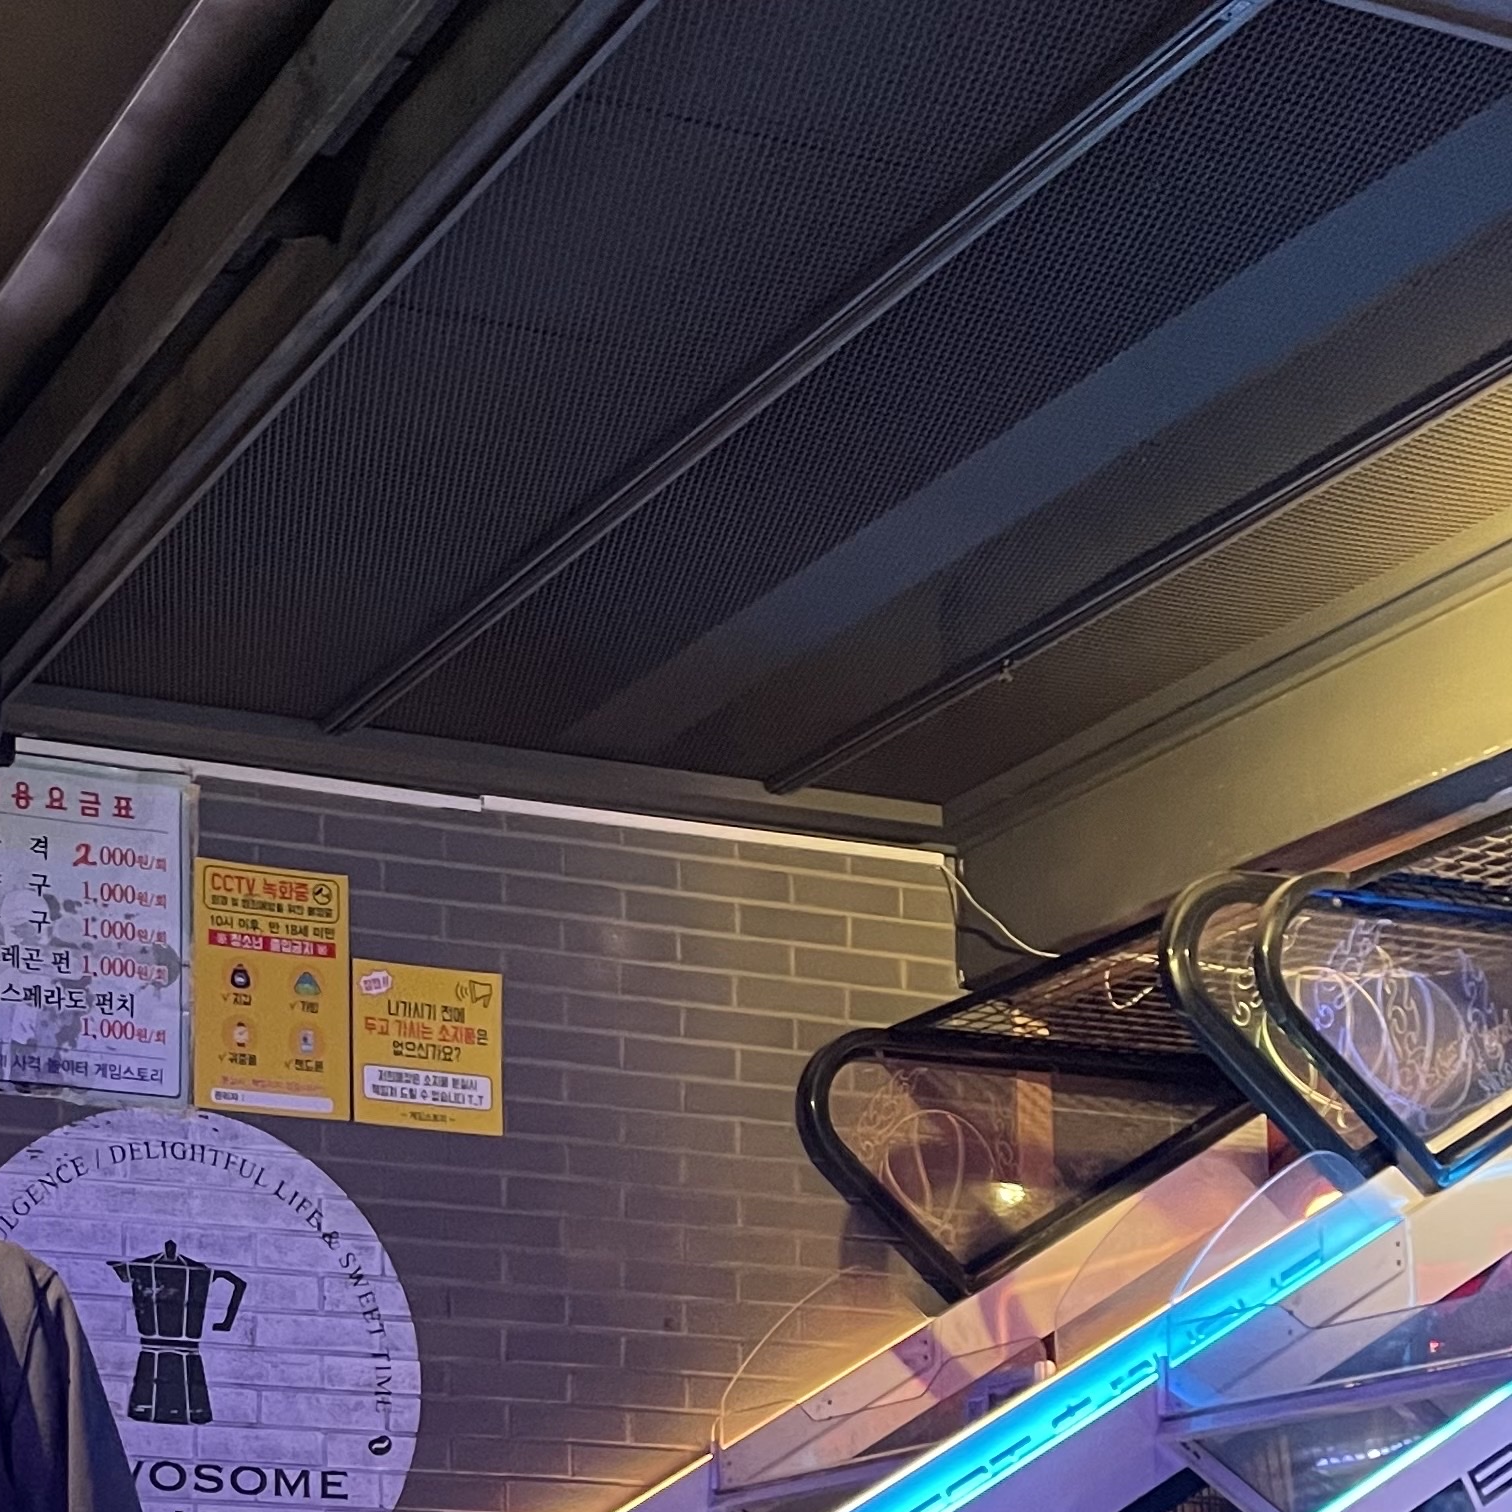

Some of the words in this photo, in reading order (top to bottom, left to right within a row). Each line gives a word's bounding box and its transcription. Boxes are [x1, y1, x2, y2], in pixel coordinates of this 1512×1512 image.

[211, 872, 256, 896] CCTV
[262, 878, 309, 903] 녹화중
[51, 951, 72, 974] 펀
[95, 991, 135, 1018] 펀치
[388, 999, 437, 1021] 나가시기
[441, 1005, 465, 1023] 전에
[364, 1016, 389, 1036] 두고
[395, 1019, 432, 1040] 가시는
[392, 1040, 461, 1062] 없으신가요?
[94, 1062, 164, 1085] 게임스토리
[108, 1140, 269, 1188] DELIGHTFUL
[273, 1180, 324, 1233] LIFE
[339, 1252, 387, 1337] SWEET
[371, 1348, 393, 1413] TIME
